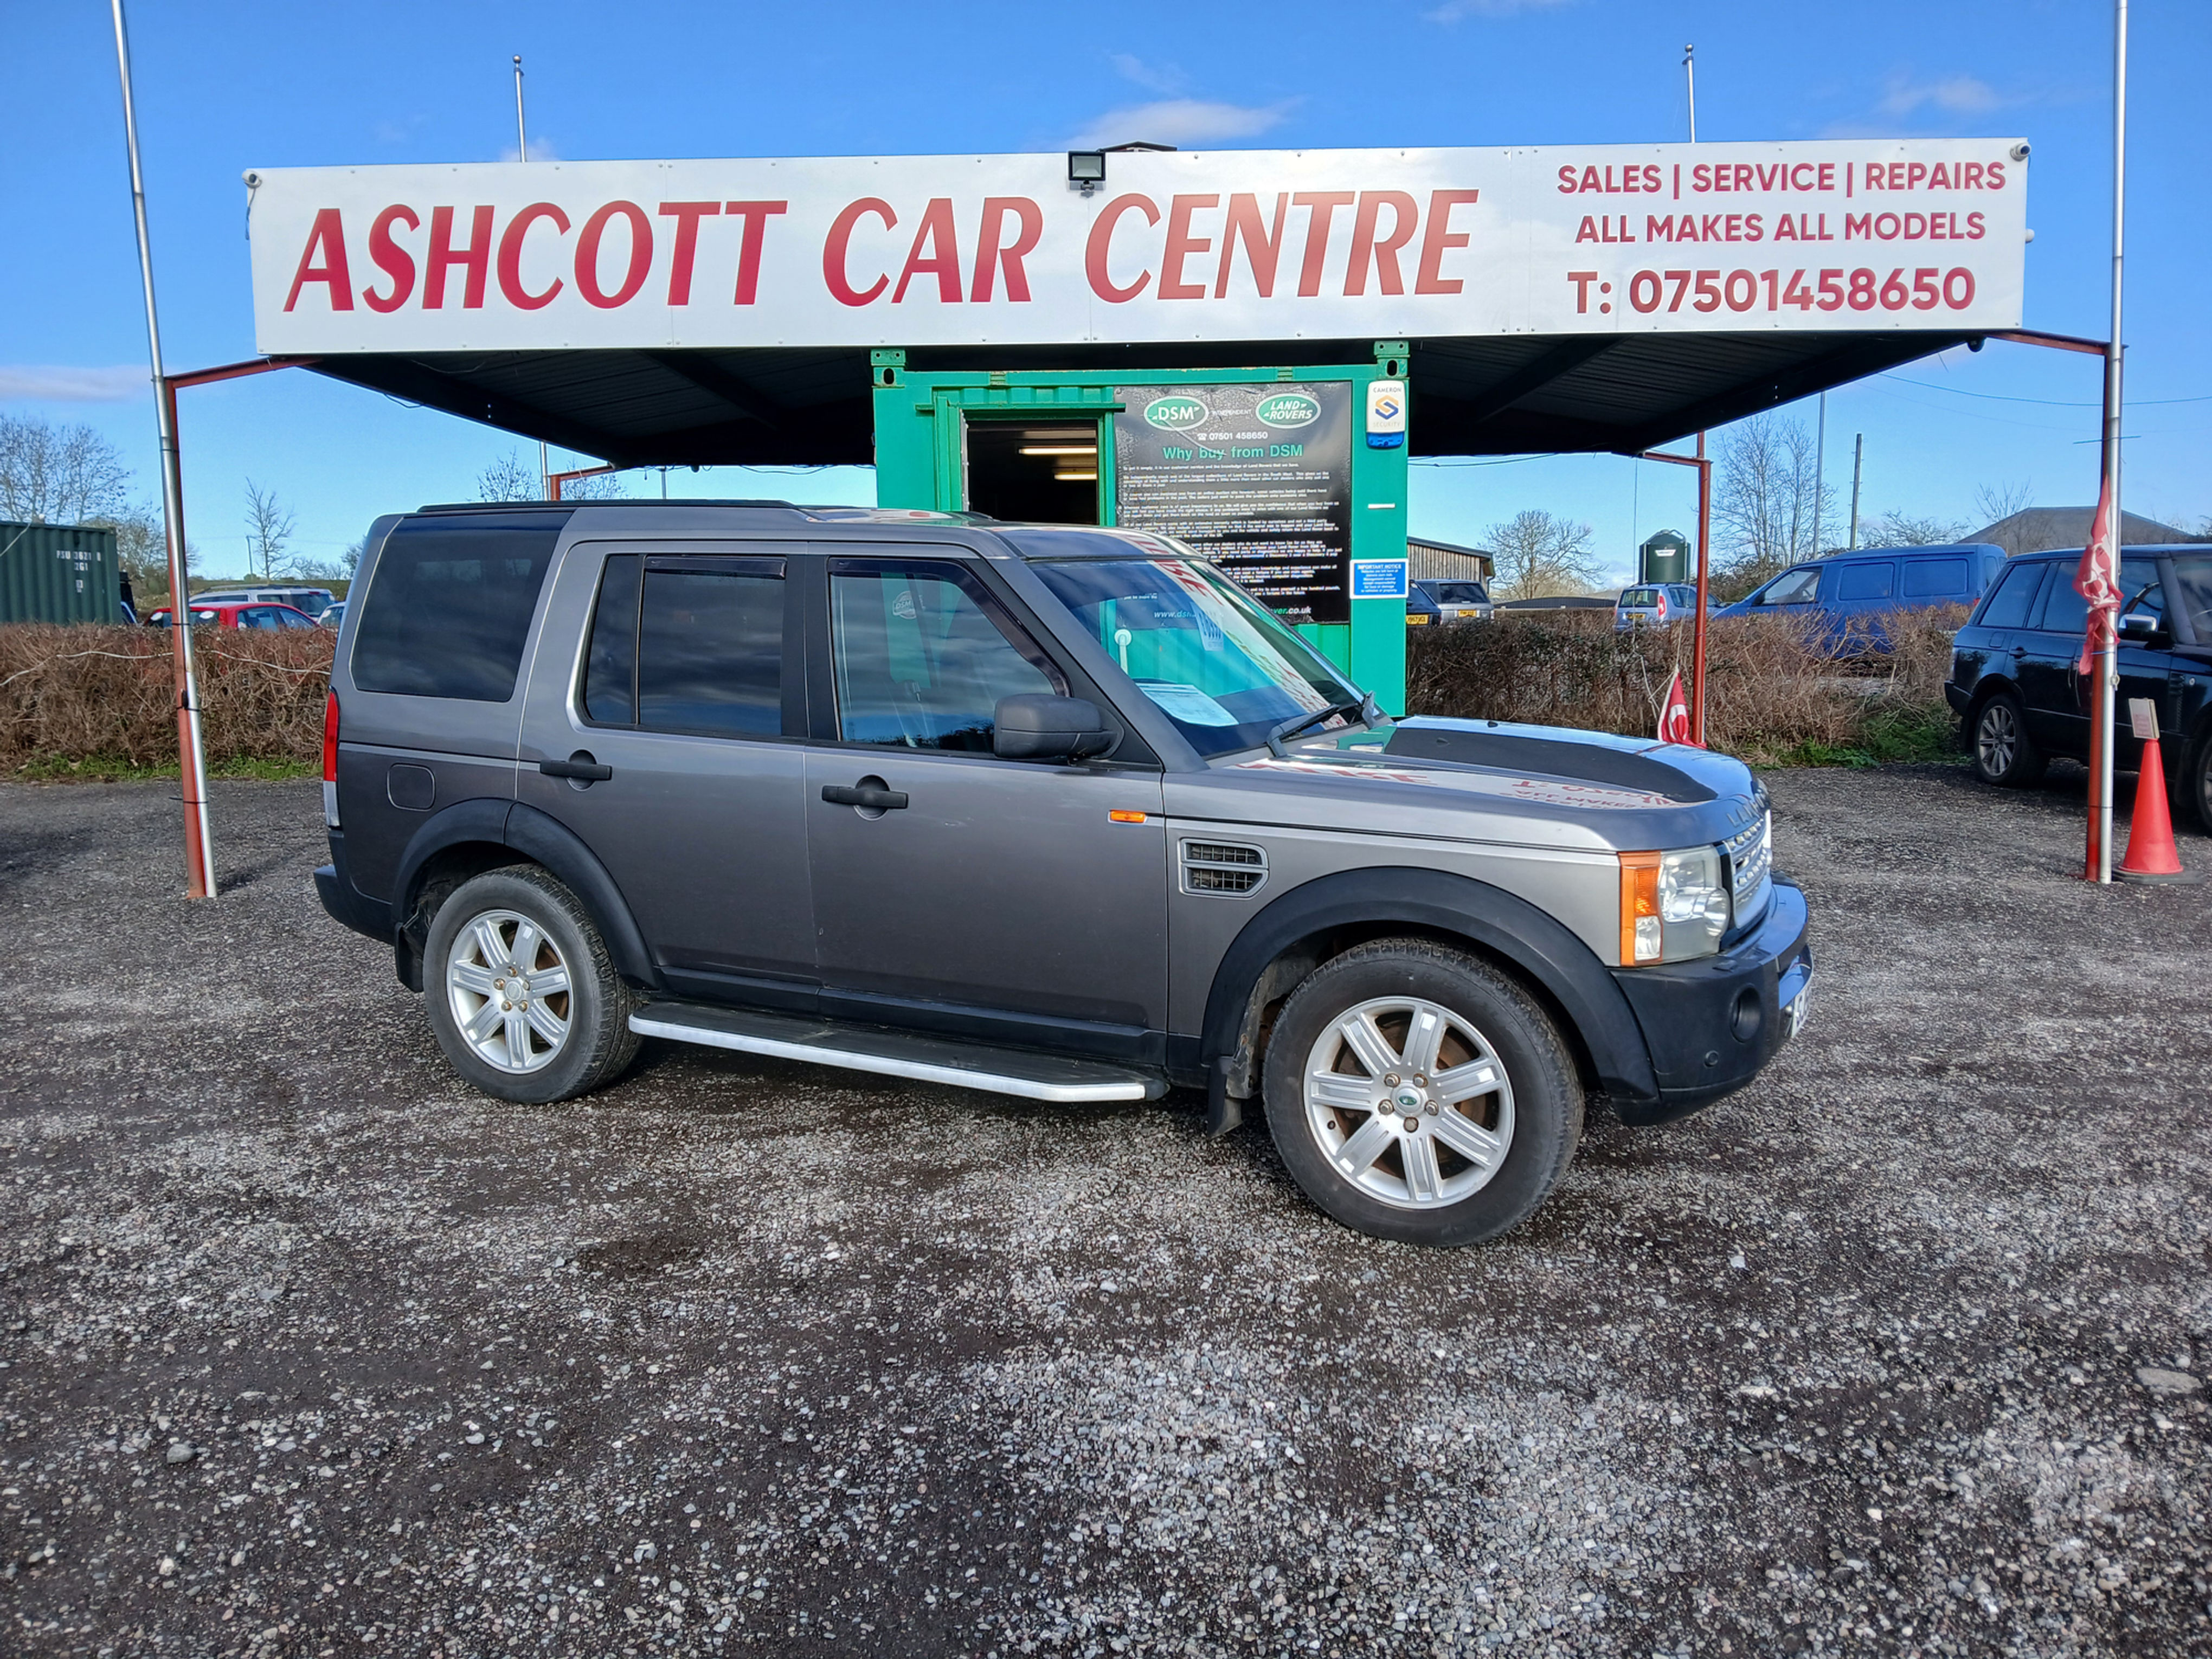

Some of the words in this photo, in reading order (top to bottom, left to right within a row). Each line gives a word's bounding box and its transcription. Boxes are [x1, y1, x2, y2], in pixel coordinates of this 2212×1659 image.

[1558, 164, 1662, 194] SALES
[1692, 163, 1835, 192] SERVICE
[1865, 162, 2006, 191] REPAIRS
[1576, 215, 1636, 243] ALL
[1647, 214, 1764, 242] MAKES
[1773, 214, 1834, 242] ALL
[1845, 211, 1986, 241] MODELS
[283, 200, 788, 313] ASHCOTT
[822, 196, 1044, 307] CAR
[1085, 190, 1479, 304] CENTRE
[1567, 272, 1612, 313] T:
[1629, 267, 1976, 313] 07501458650
[1158, 407, 1195, 421] DSM
[1270, 401, 1301, 410] LAND
[1269, 409, 1313, 420] ROVERS
[1208, 432, 1233, 441] 07501
[1162, 447, 1193, 461] Why
[1199, 446, 1225, 461] buy
[1231, 445, 1264, 458] from
[1269, 444, 1304, 458] DSM
